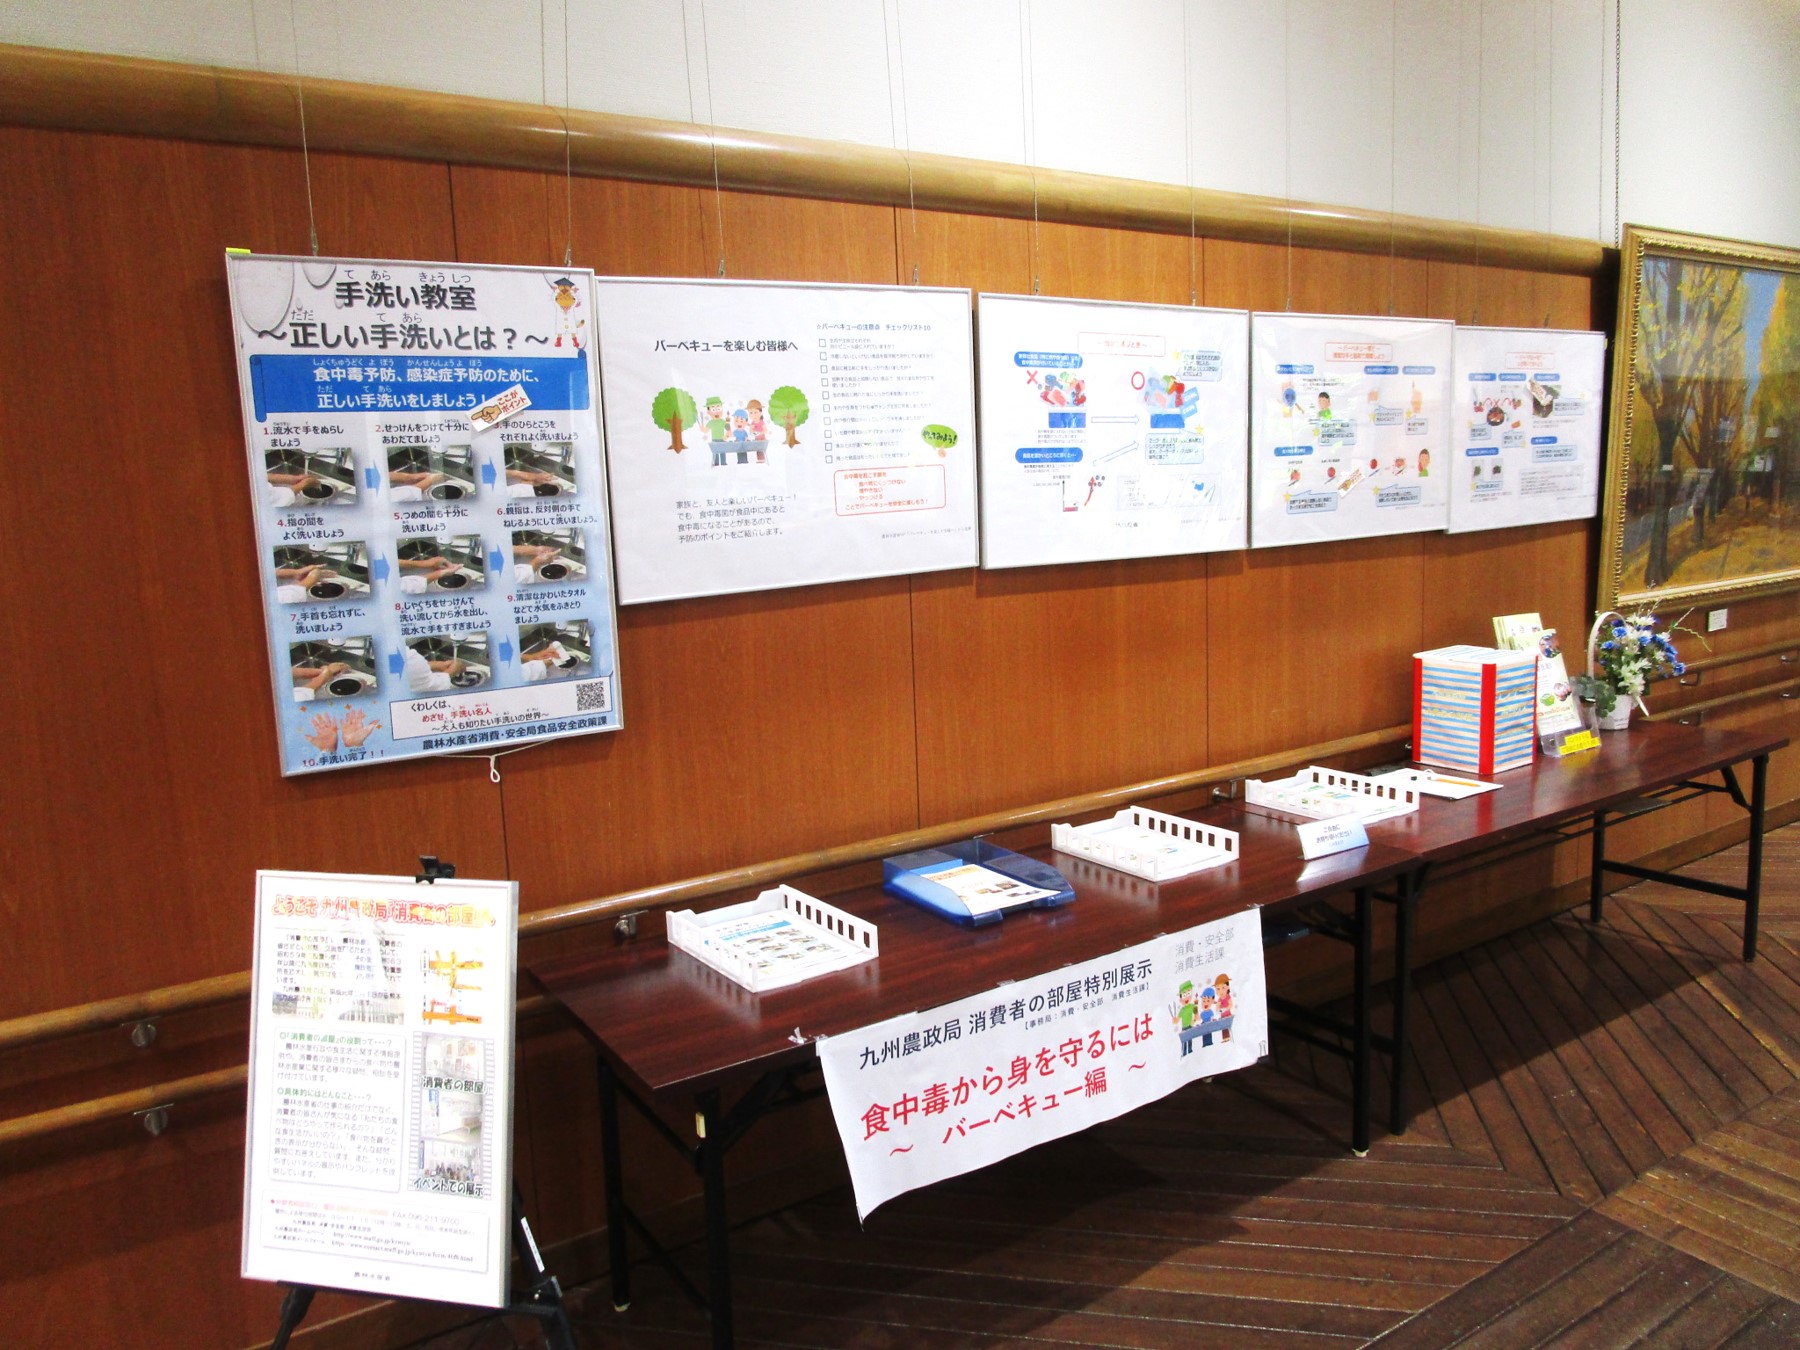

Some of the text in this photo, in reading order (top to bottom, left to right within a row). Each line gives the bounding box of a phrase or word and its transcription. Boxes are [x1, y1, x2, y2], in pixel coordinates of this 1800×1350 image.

[335, 281, 477, 311] 手洗い教室
[654, 339, 798, 353] バーベキューを楽しむ皆様へ
[313, 367, 539, 383] 食中毒予防、感染症予防のために、
[501, 396, 527, 413] ポイント
[271, 438, 301, 447] ましょう
[382, 434, 441, 444] あわだてましょう
[500, 432, 579, 442] それぞれよく洗いましょう
[283, 528, 344, 540] よく洗いましょう
[402, 523, 446, 533] 洗いましょう
[513, 602, 581, 614] などで水気をふきとり
[515, 615, 540, 624] ましょう
[296, 623, 343, 634] 洗いましょう
[411, 701, 451, 712] くわしくは、
[1174, 927, 1236, 960] 消費・安全部
[1174, 946, 1226, 974] 消費生活課
[859, 958, 1153, 1070] 九州農政局 消費者の部屋特別展示
[860, 1012, 1154, 1142] 食中毒から身を守るには
[942, 1066, 1108, 1145] バーベキュー編
